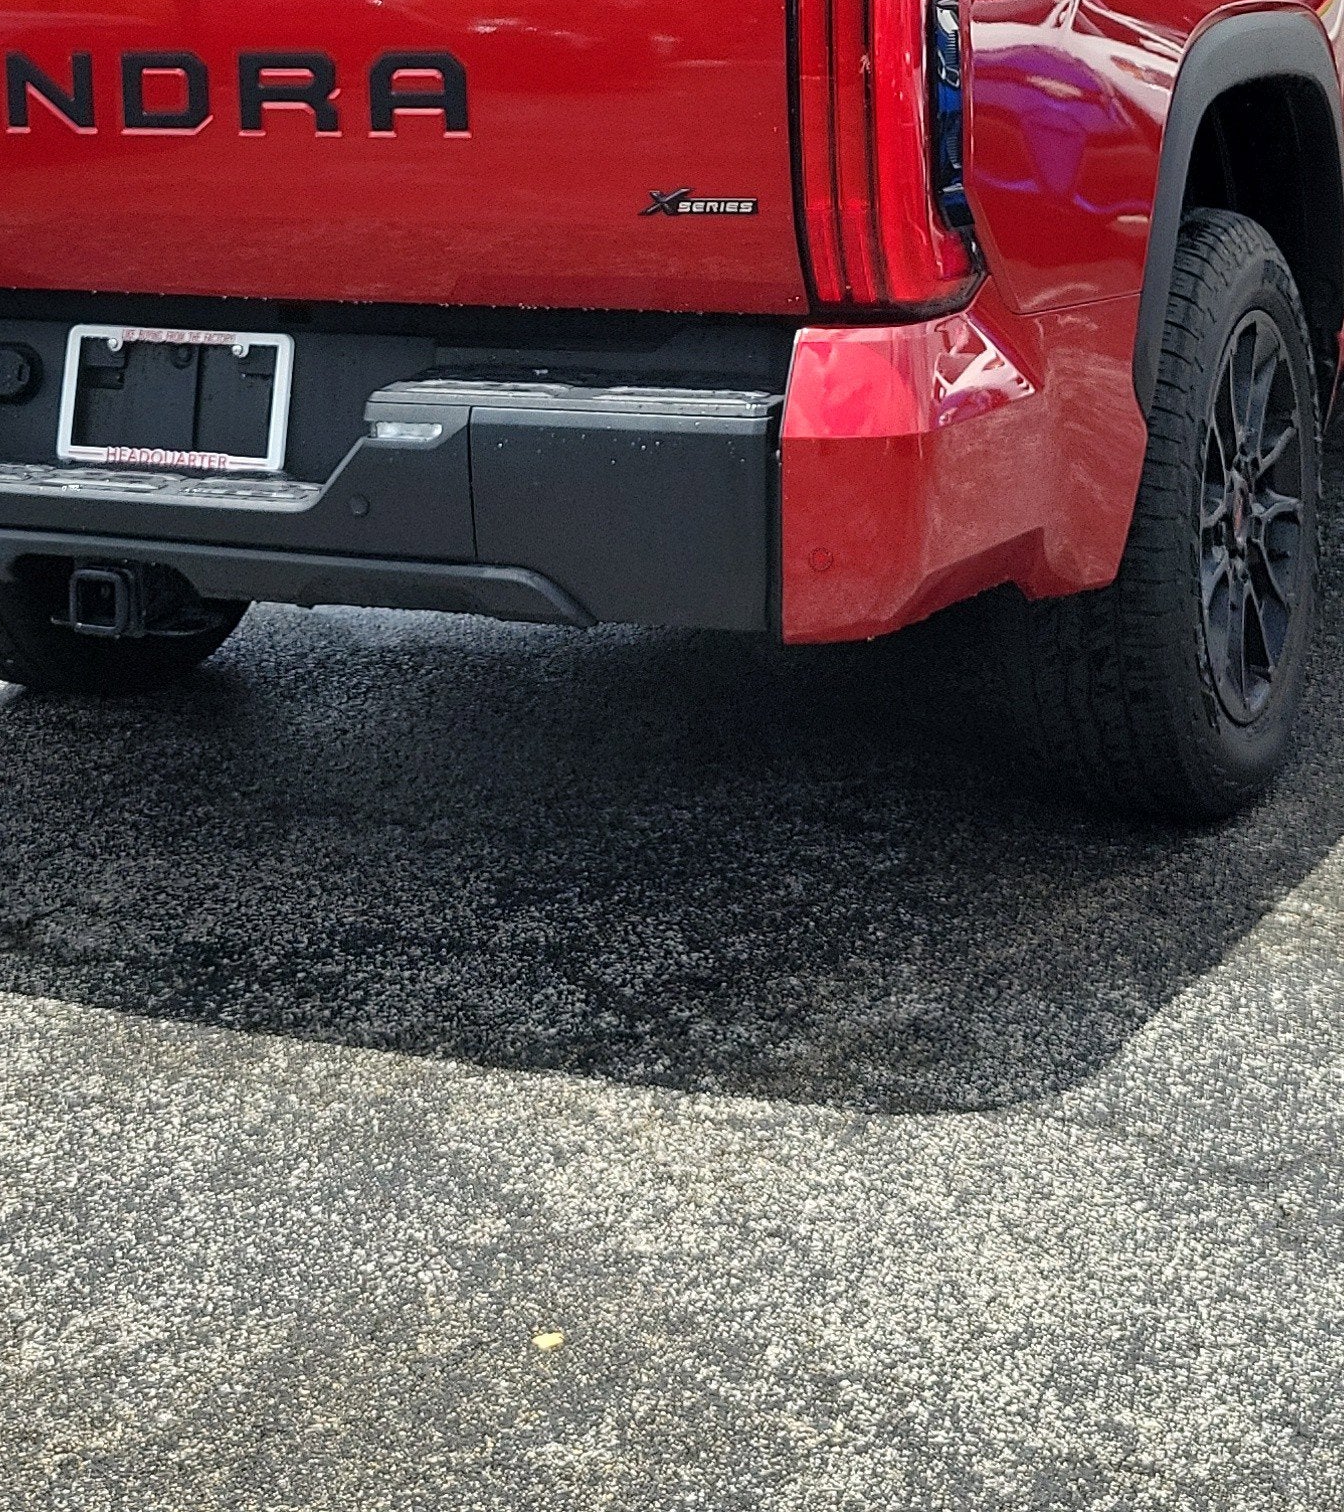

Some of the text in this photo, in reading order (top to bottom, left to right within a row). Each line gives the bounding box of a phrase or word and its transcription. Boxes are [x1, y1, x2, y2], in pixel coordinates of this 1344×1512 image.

[638, 186, 754, 216] X SERIES
[106, 447, 228, 468] HEADQUARTER
